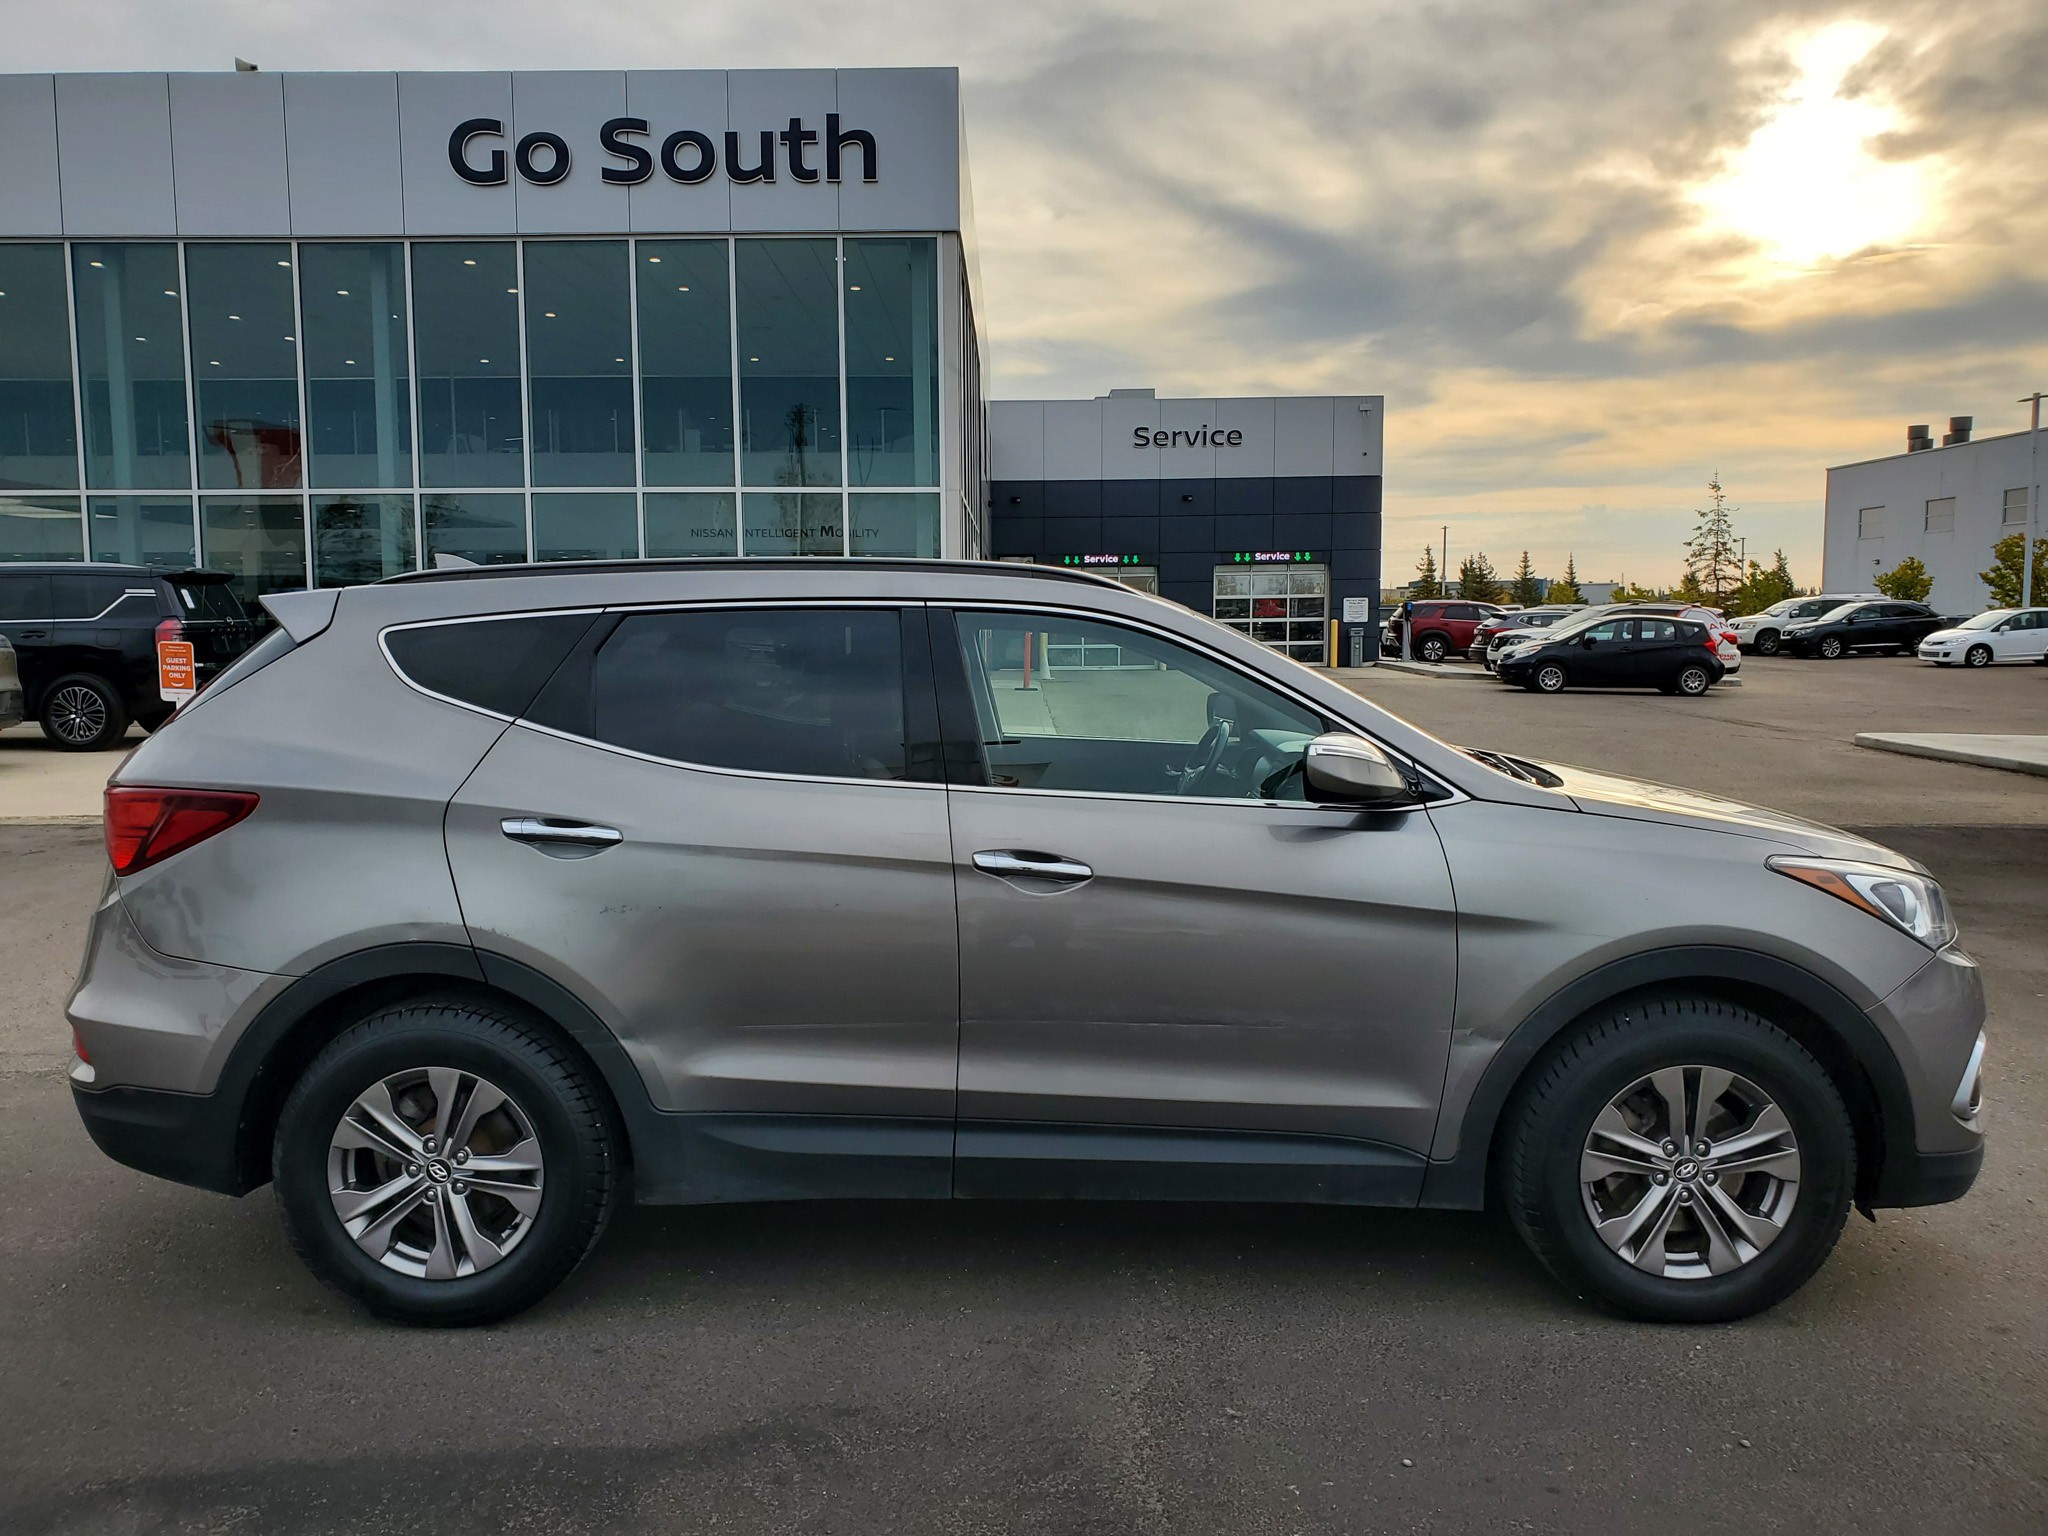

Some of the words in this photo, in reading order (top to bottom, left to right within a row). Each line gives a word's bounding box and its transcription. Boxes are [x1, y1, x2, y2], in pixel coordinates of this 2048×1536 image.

[448, 117, 572, 186] Go
[599, 113, 878, 185] South
[1133, 424, 1242, 447] Service
[691, 528, 733, 538] NISSAN
[744, 528, 816, 538] NTELLIGENT
[820, 525, 879, 538] MOILITY
[1084, 554, 1119, 564] Service
[1255, 552, 1290, 561] Service
